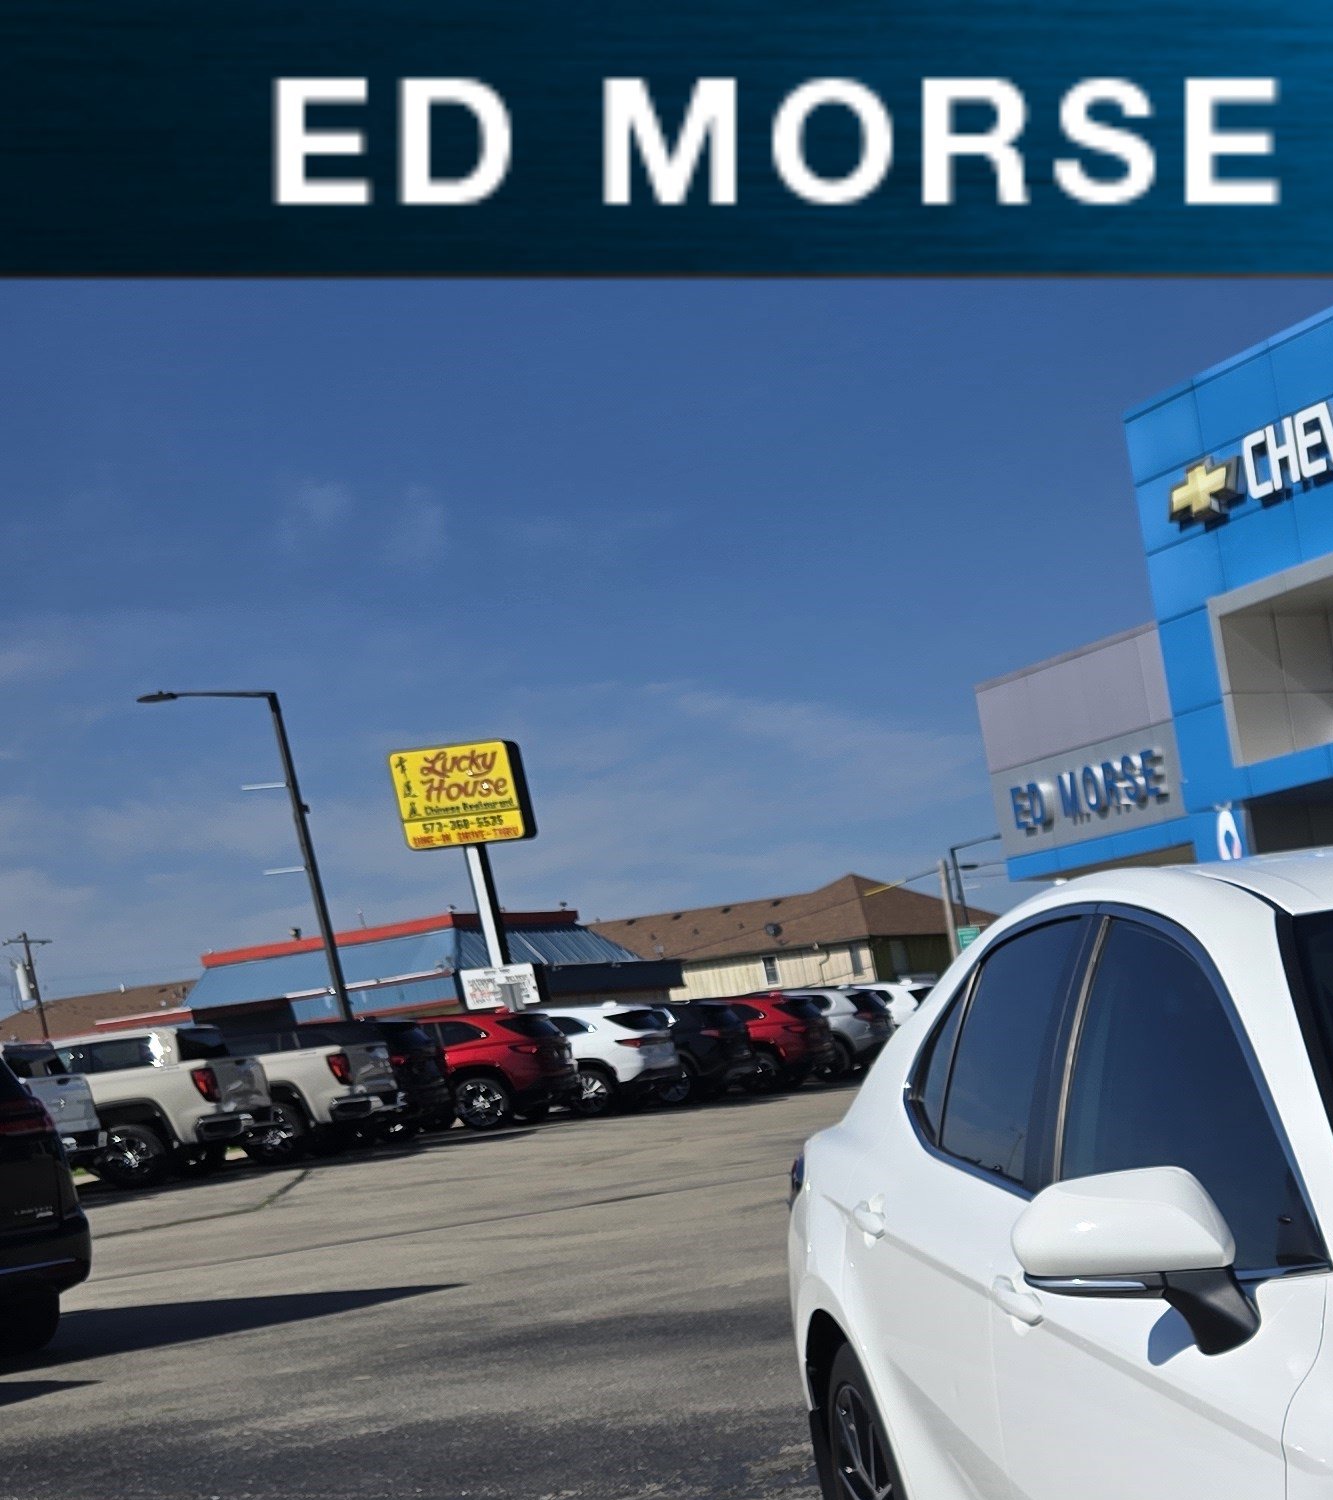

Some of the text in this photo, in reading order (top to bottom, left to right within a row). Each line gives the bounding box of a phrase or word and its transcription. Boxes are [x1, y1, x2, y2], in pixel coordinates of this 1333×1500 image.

[420, 750, 498, 779] Lucky
[420, 777, 508, 803] House
[1010, 749, 1164, 830] ED MORSE
